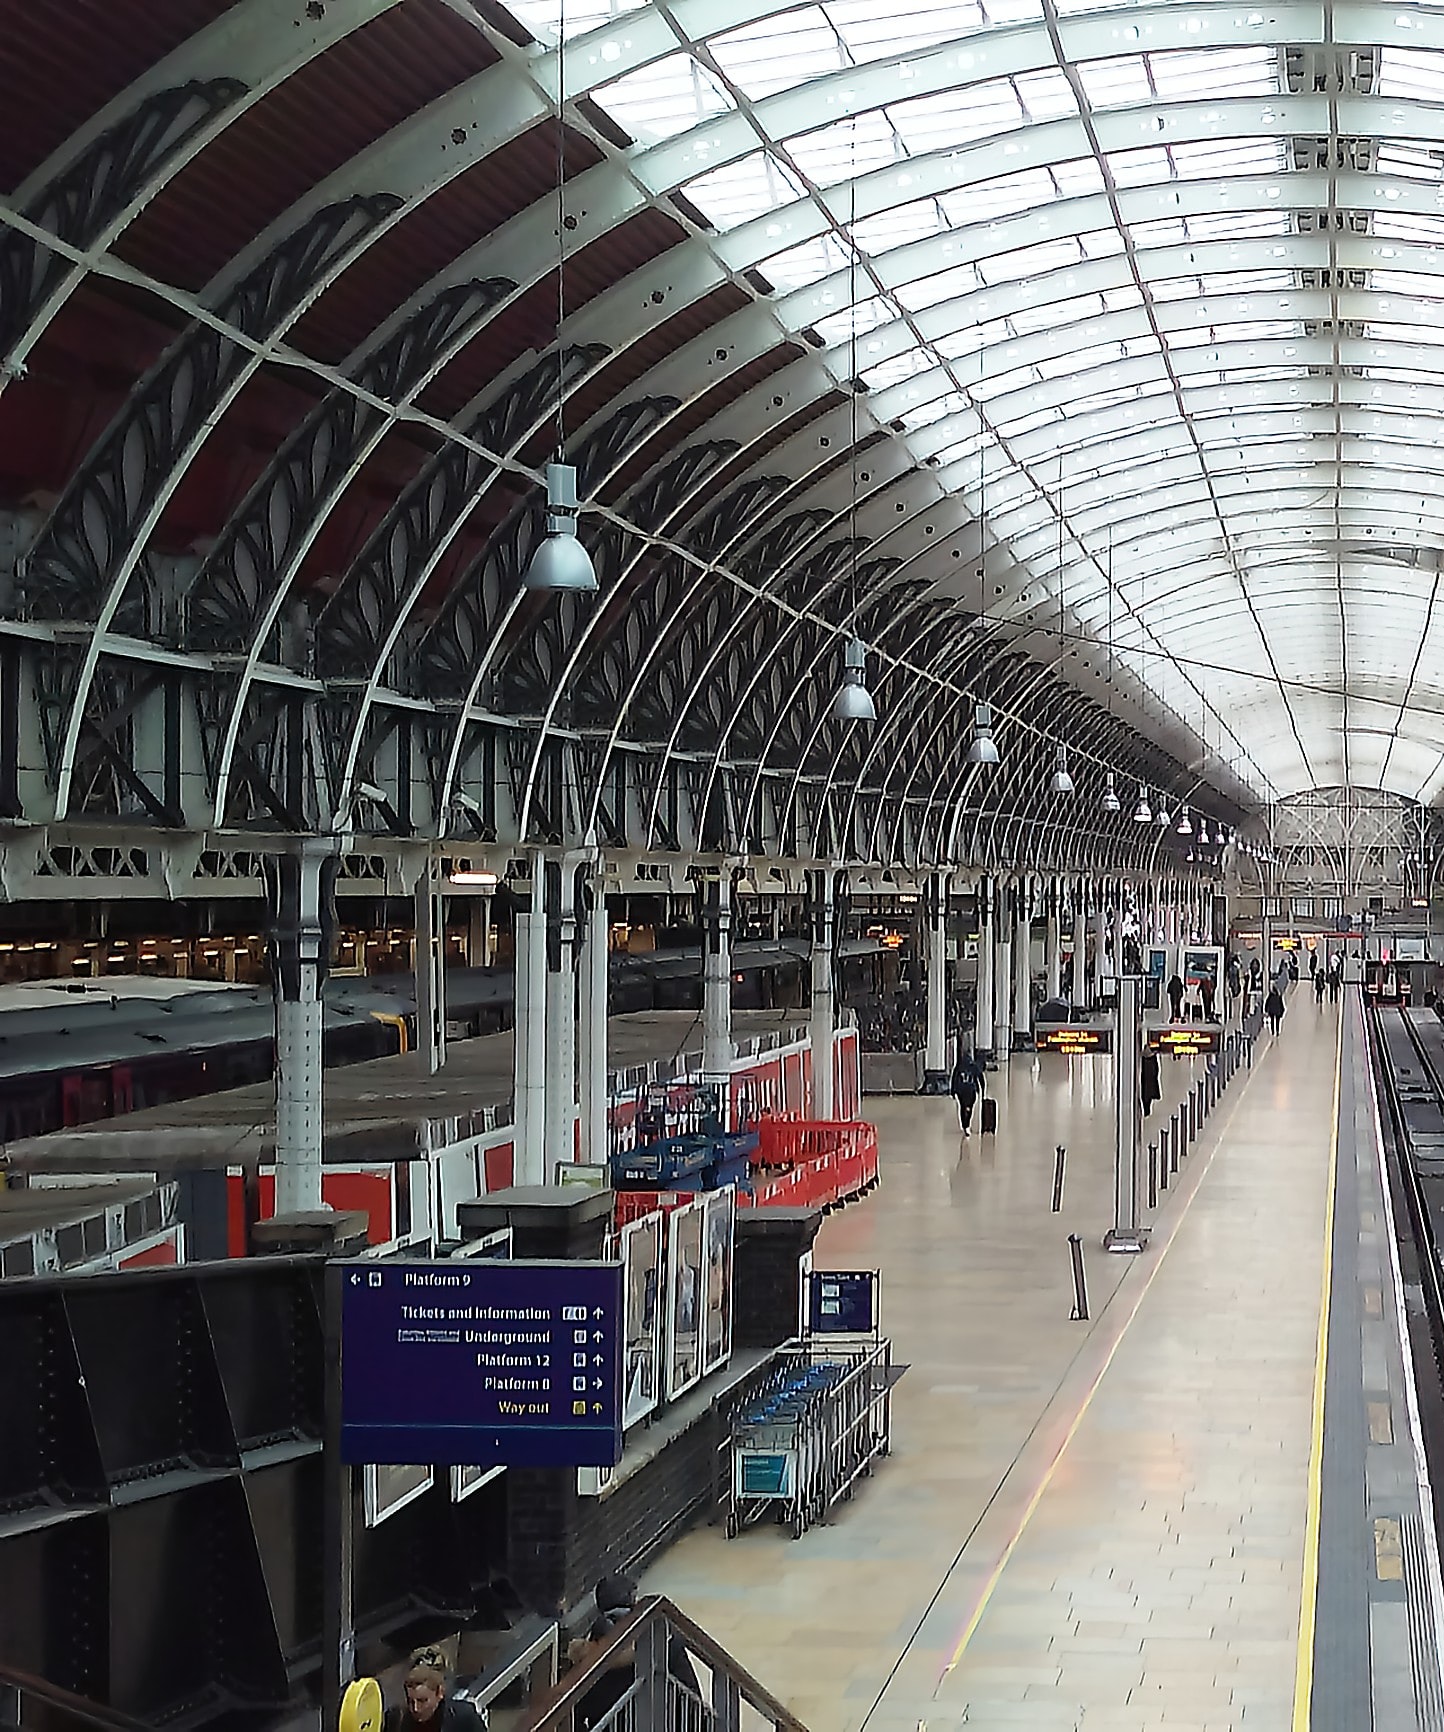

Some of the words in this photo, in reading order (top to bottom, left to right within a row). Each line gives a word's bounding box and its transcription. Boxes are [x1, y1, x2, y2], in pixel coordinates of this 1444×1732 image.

[405, 1273, 460, 1287] Platform
[462, 1273, 471, 1287] 9
[401, 1305, 445, 1320] Tickets
[448, 1306, 473, 1320] and
[475, 1306, 551, 1321] Information
[465, 1329, 550, 1346] Underground
[477, 1353, 532, 1367] Platform
[536, 1353, 550, 1367] 12
[484, 1376, 539, 1391] Platform
[498, 1400, 526, 1416] Way
[528, 1402, 549, 1415] out
